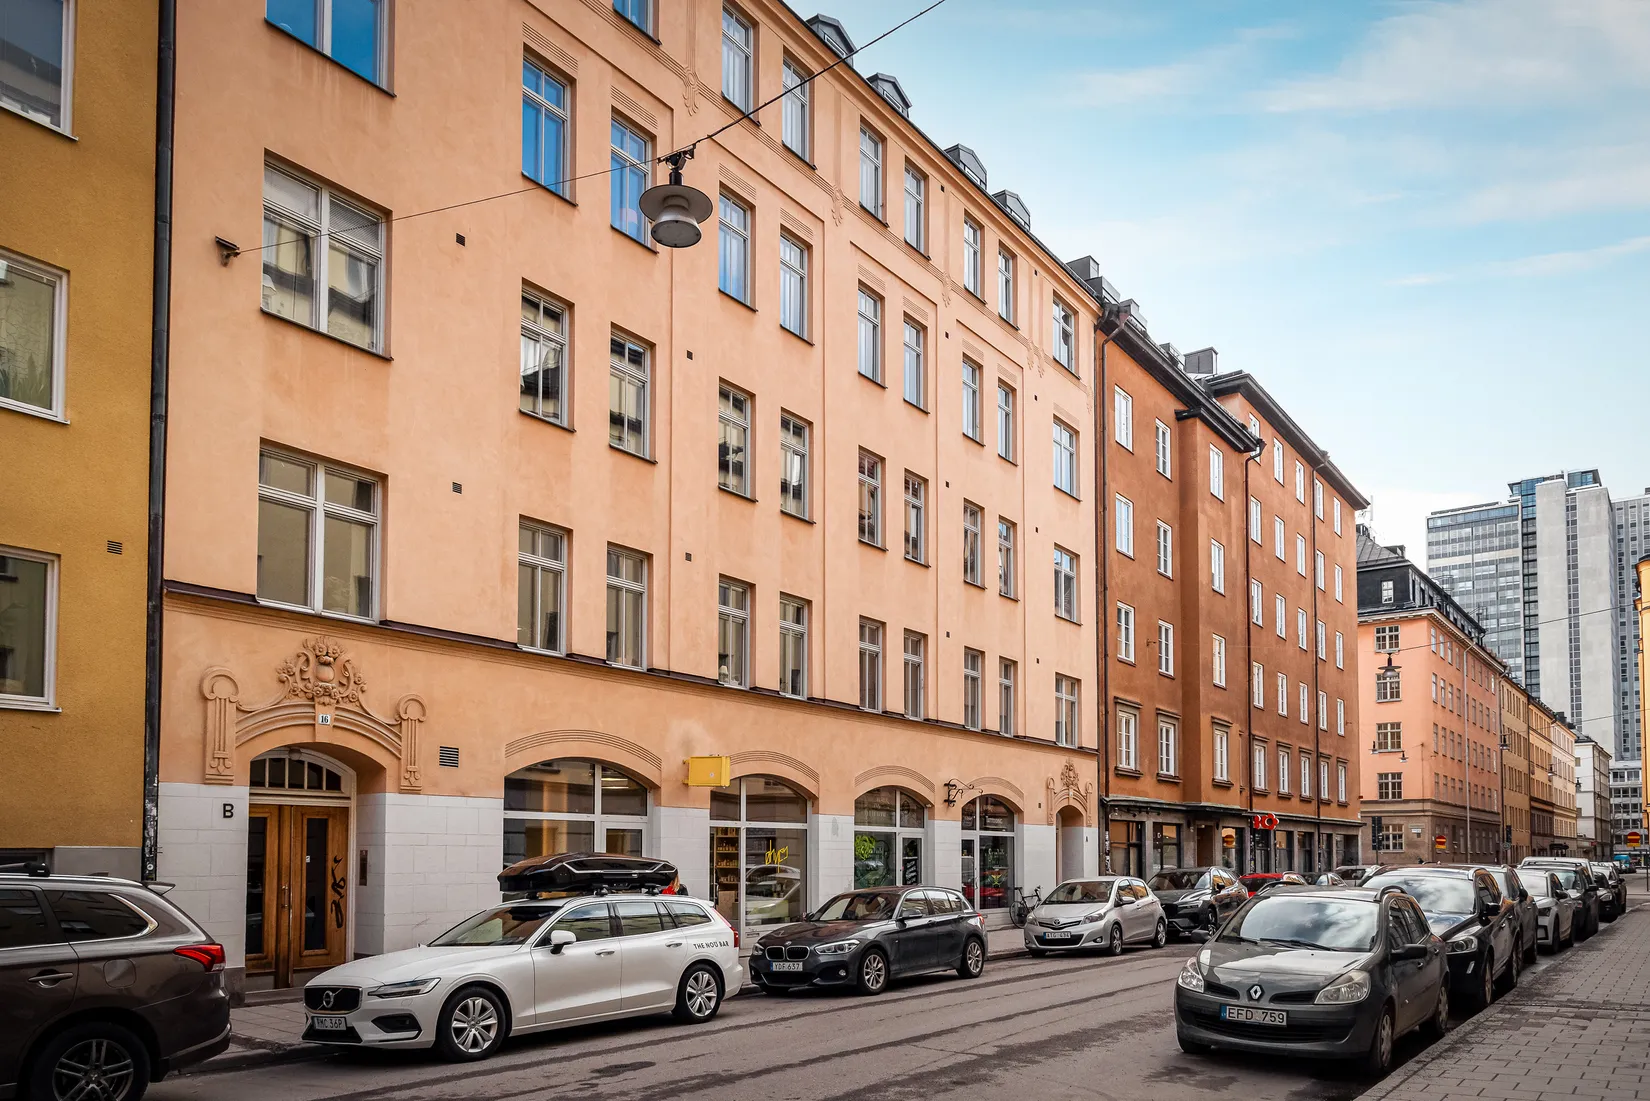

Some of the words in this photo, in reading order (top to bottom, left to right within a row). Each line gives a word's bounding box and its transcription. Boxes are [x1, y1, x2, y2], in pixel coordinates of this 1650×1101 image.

[321, 715, 329, 723] 16
[222, 803, 234, 818] B
[719, 940, 729, 948] BAR
[1228, 1007, 1253, 1021] EFD
[1262, 1011, 1285, 1024] 759
[329, 1019, 343, 1029] 36P
